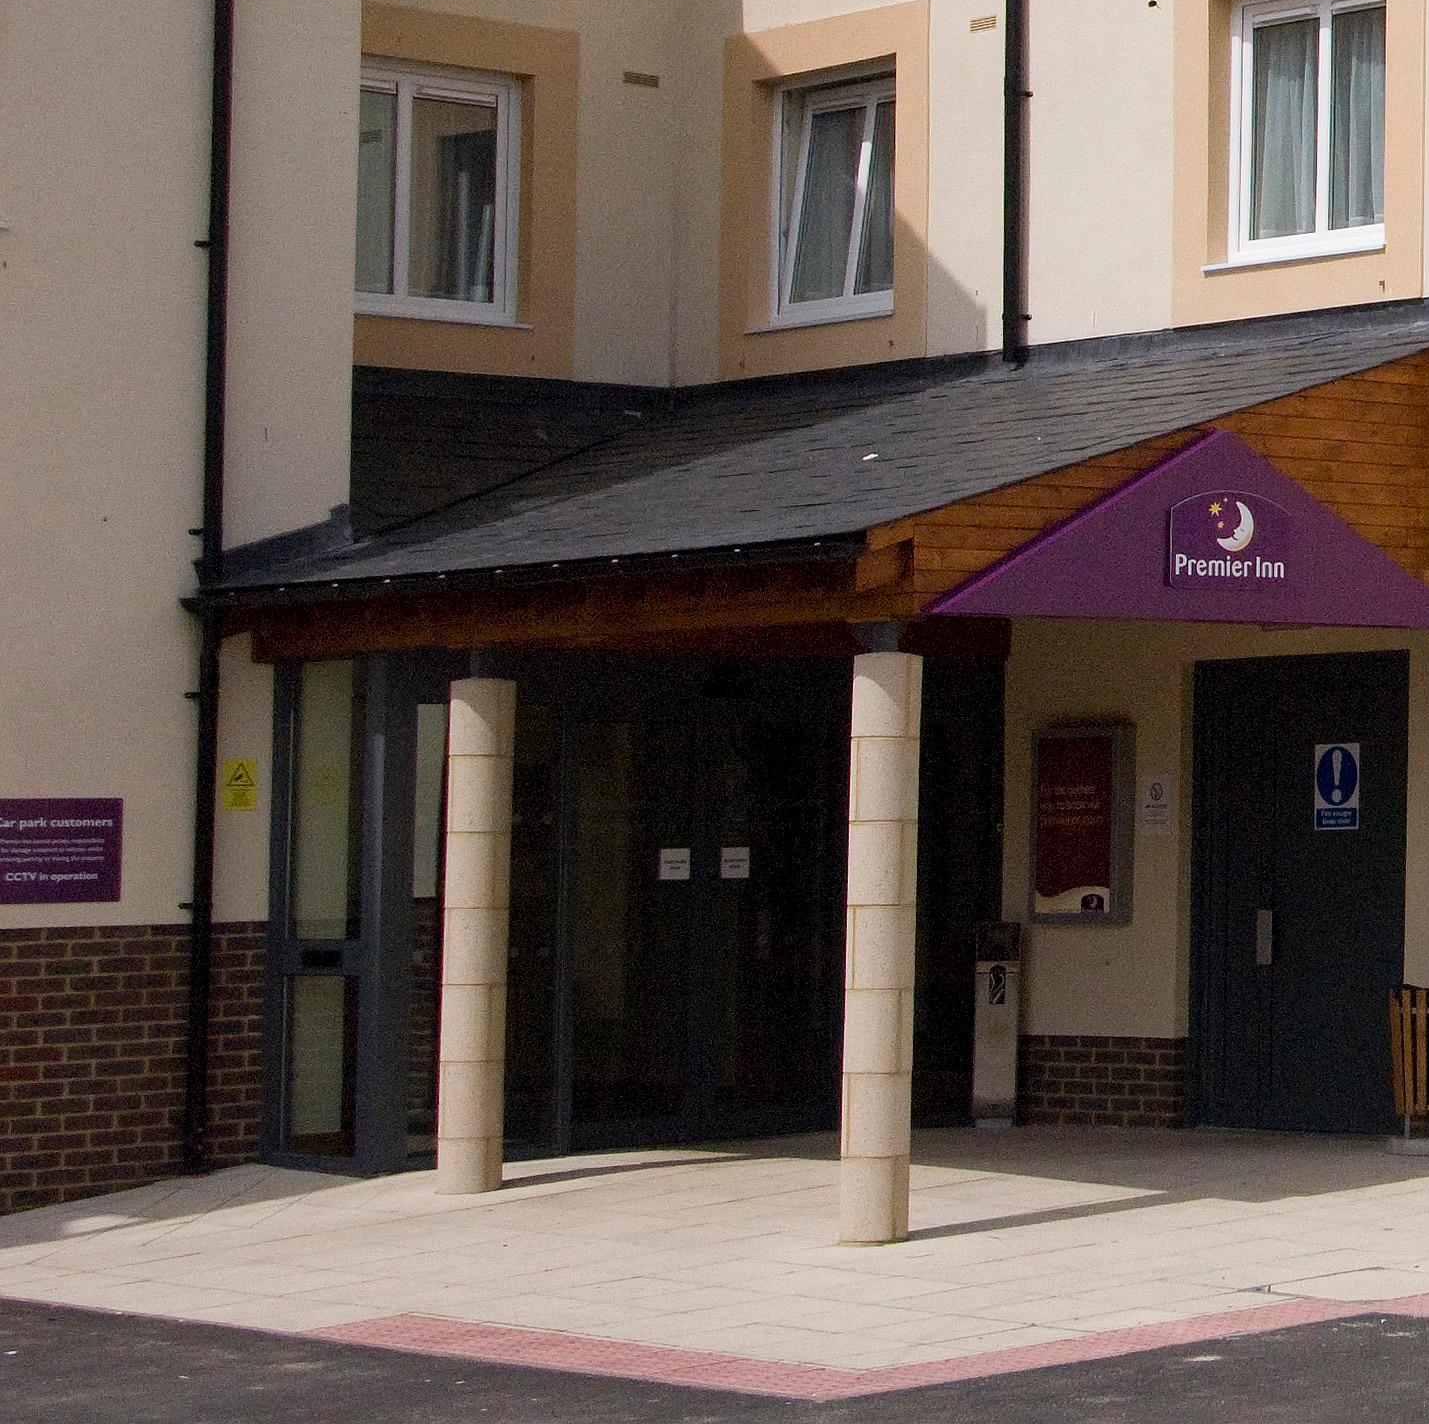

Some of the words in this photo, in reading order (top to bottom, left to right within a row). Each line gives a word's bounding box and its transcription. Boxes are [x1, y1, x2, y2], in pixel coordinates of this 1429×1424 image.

[1175, 553, 1252, 577] Premier
[1256, 556, 1285, 579] Inn
[20, 817, 47, 830] park
[50, 818, 114, 828] customers
[5, 872, 37, 882] CCTV
[39, 872, 49, 881] in
[50, 872, 98, 883] operation
